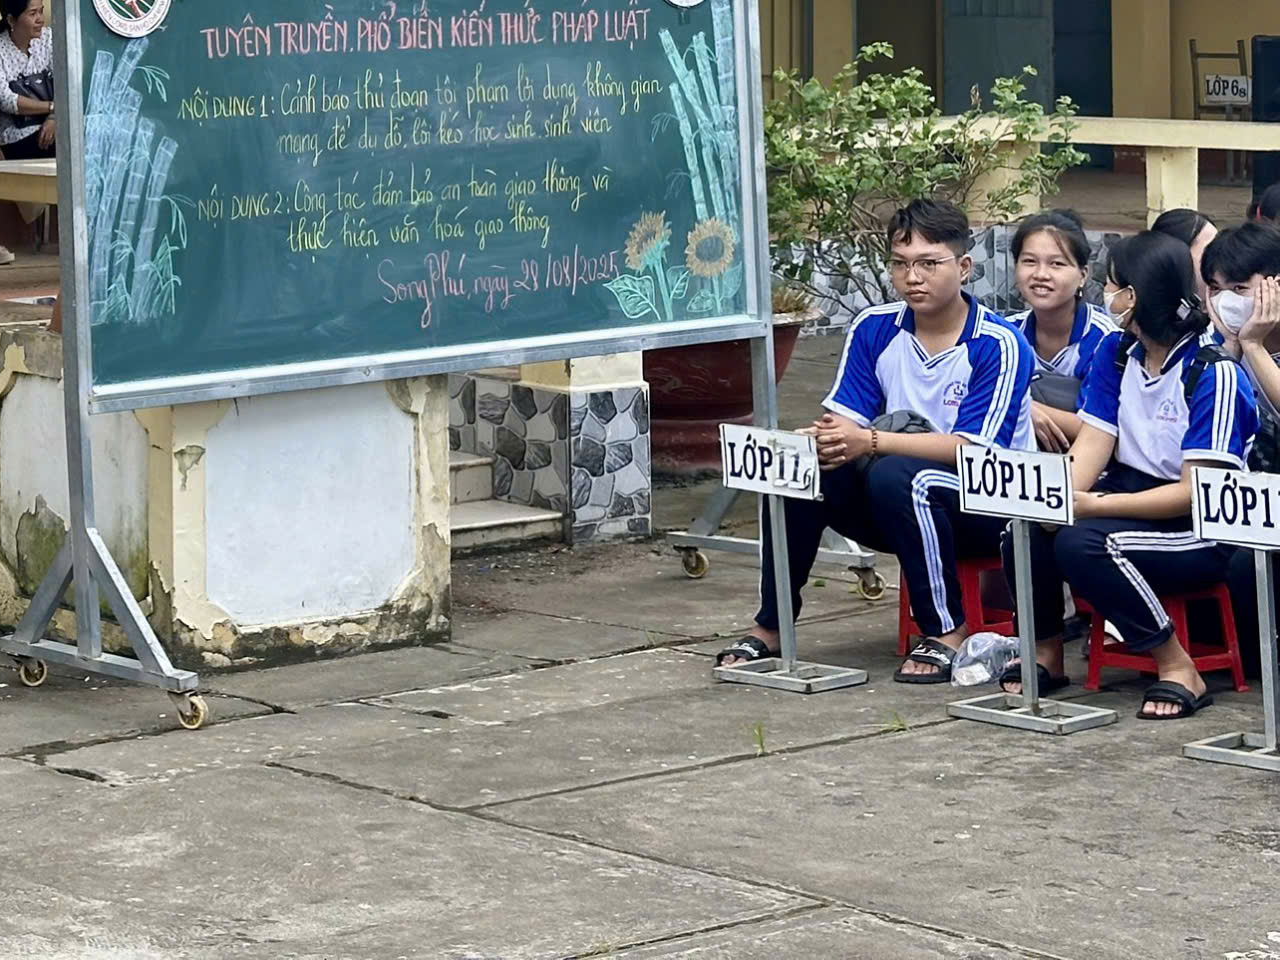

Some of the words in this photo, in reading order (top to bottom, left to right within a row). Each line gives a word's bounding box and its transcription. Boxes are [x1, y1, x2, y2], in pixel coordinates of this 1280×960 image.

[199, 12, 271, 59] TUYÊN
[357, 0, 397, 53] PHỔ
[450, 0, 493, 48] KIẾN
[213, 95, 256, 118] DUNG
[280, 73, 317, 116] Cảnh
[322, 76, 350, 112] báo
[353, 68, 384, 115] thủ
[390, 68, 429, 113] đoạn
[435, 74, 457, 113] tội
[467, 62, 509, 119] phạm
[543, 63, 579, 116] dụng
[582, 60, 627, 116] không
[631, 74, 663, 113] gian
[1206, 74, 1230, 96] LỚP
[278, 131, 323, 167] mạng
[327, 114, 352, 151] để
[358, 115, 377, 157] dụ
[412, 117, 432, 146] lôi
[436, 111, 464, 145] kéo
[471, 110, 500, 148] học
[545, 104, 573, 139] sinh
[580, 107, 613, 133] viên
[231, 192, 270, 221] DUNG
[294, 178, 333, 230] Công
[336, 171, 367, 211] tác
[372, 168, 403, 206] đảm
[410, 161, 433, 206] bảo
[441, 184, 462, 201] an
[467, 163, 497, 197] toàn
[504, 171, 536, 210] giao
[541, 157, 588, 212] thông
[592, 166, 613, 192] và
[286, 216, 333, 264] thực
[341, 212, 380, 260] hiện
[389, 213, 419, 244] văn
[428, 204, 468, 243] hoá
[474, 217, 504, 251] giao
[509, 201, 551, 249] thông
[377, 259, 432, 329] Song
[474, 265, 516, 313] ngày
